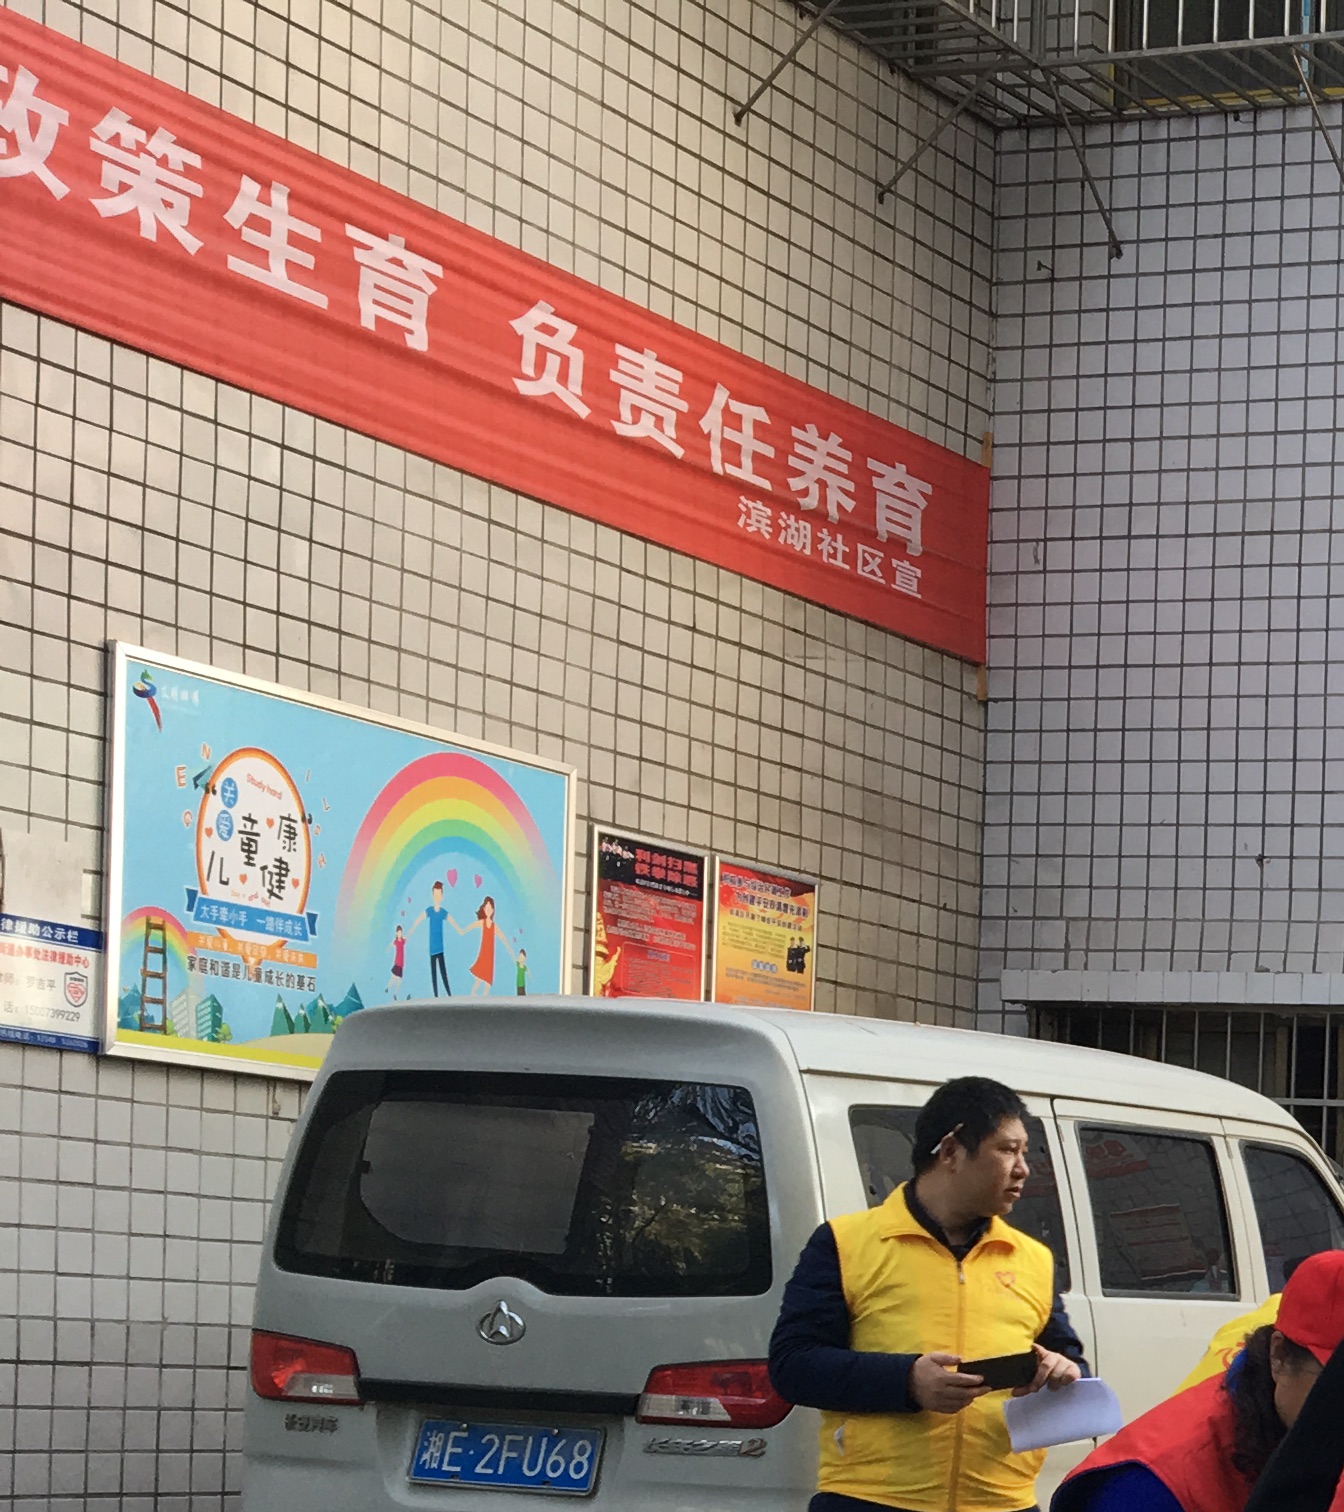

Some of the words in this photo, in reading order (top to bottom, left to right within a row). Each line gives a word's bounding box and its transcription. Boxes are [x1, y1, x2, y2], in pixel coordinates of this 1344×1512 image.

[0, 62, 445, 353] 政策生育
[508, 299, 935, 558] 负责任养育
[737, 495, 924, 601] 滨湖社区宣
[187, 955, 317, 993] 家庭和谐是儿童成长的基石
[419, 1430, 592, 1480] 湘E·2FU68
